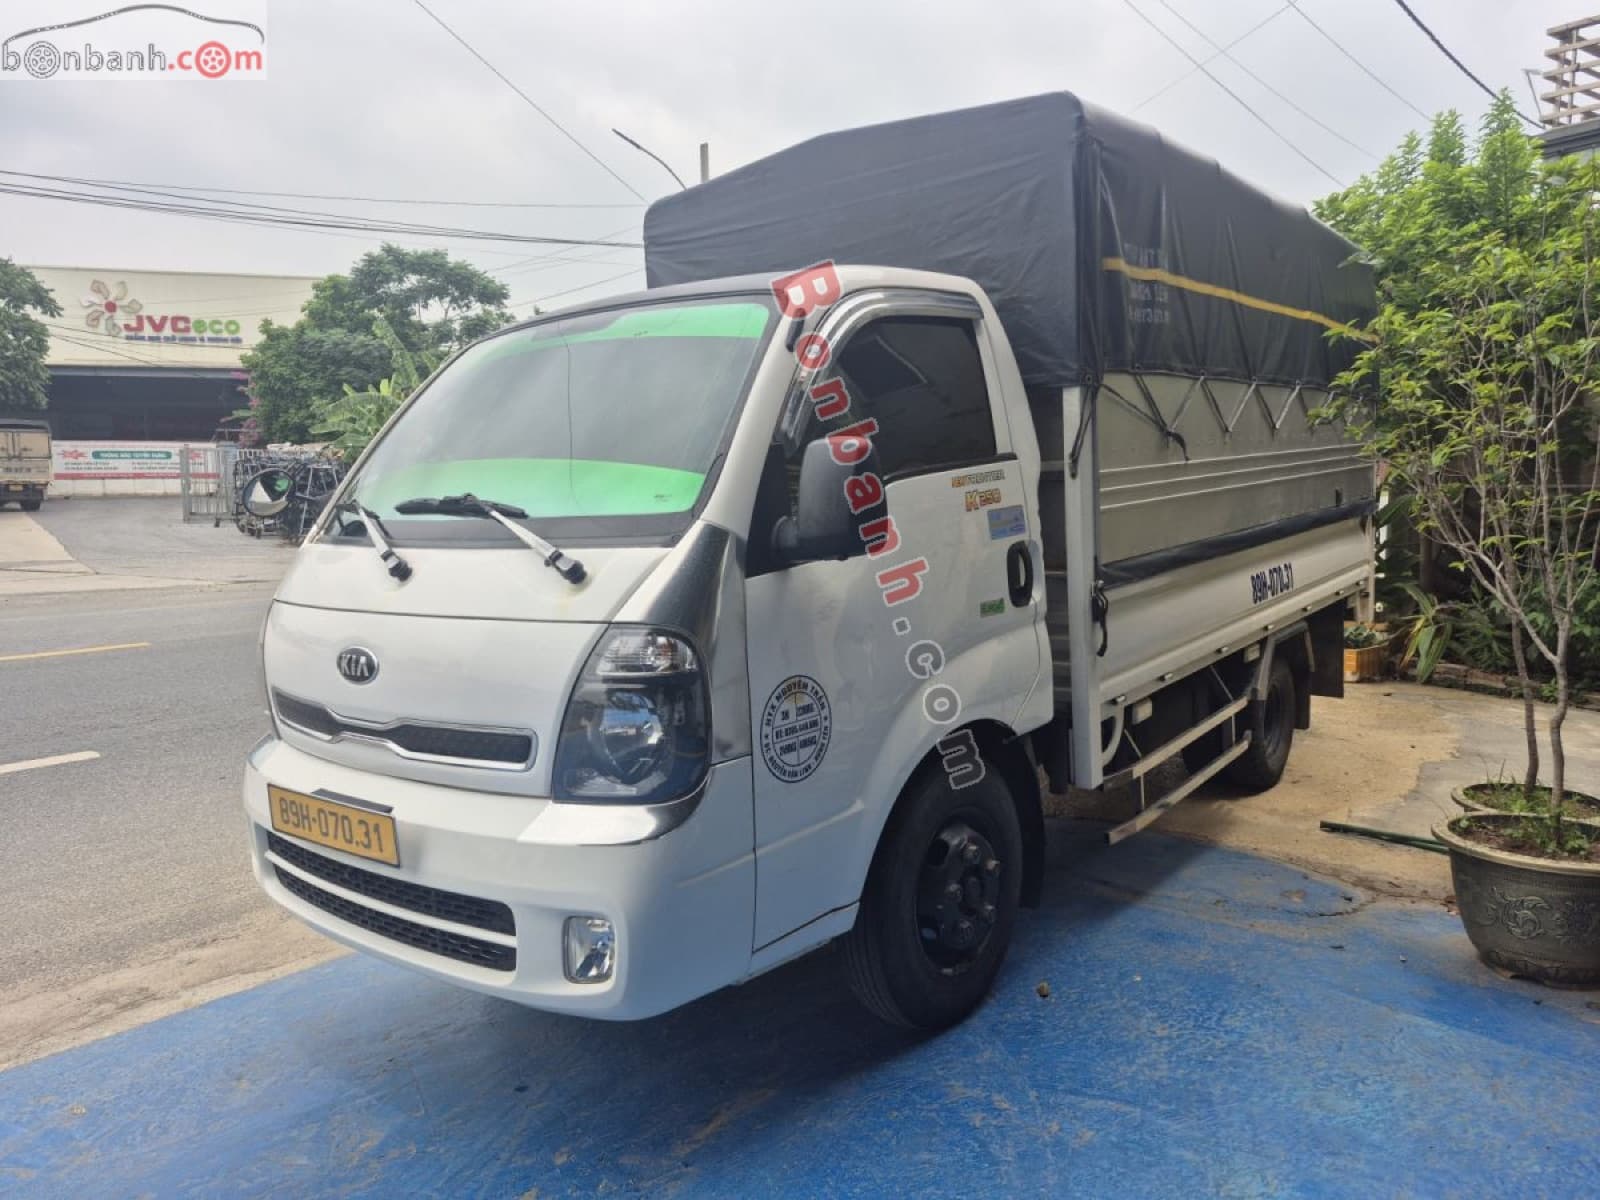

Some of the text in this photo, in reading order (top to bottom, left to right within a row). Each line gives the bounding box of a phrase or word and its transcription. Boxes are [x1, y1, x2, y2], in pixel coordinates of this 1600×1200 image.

[1250, 562, 1294, 604] 89H-070.31
[340, 654, 369, 677] KIA
[279, 796, 384, 853] 89H-070.31
